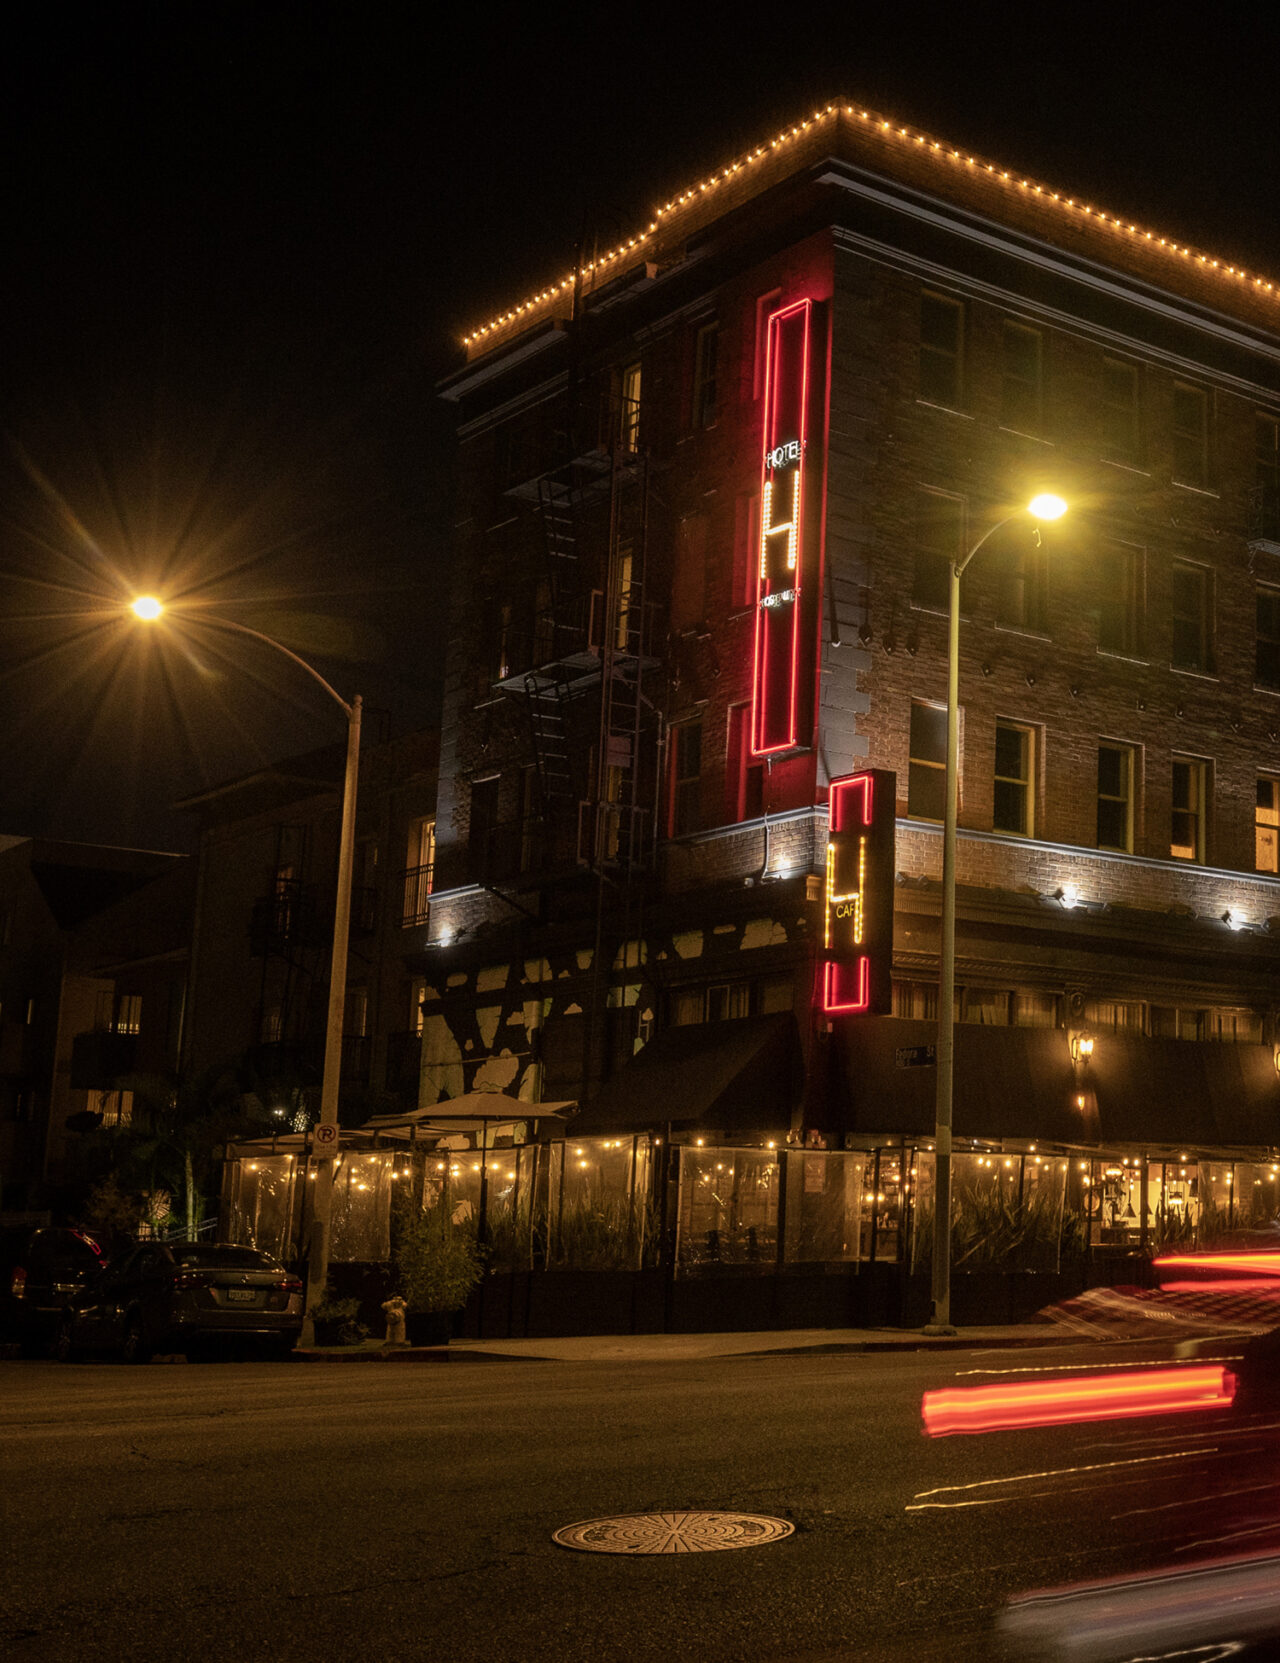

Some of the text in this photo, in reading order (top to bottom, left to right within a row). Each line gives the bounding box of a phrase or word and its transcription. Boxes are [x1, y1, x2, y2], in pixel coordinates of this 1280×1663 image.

[767, 440, 801, 469] HOTEL
[761, 470, 800, 579] H
[824, 836, 865, 949] H
